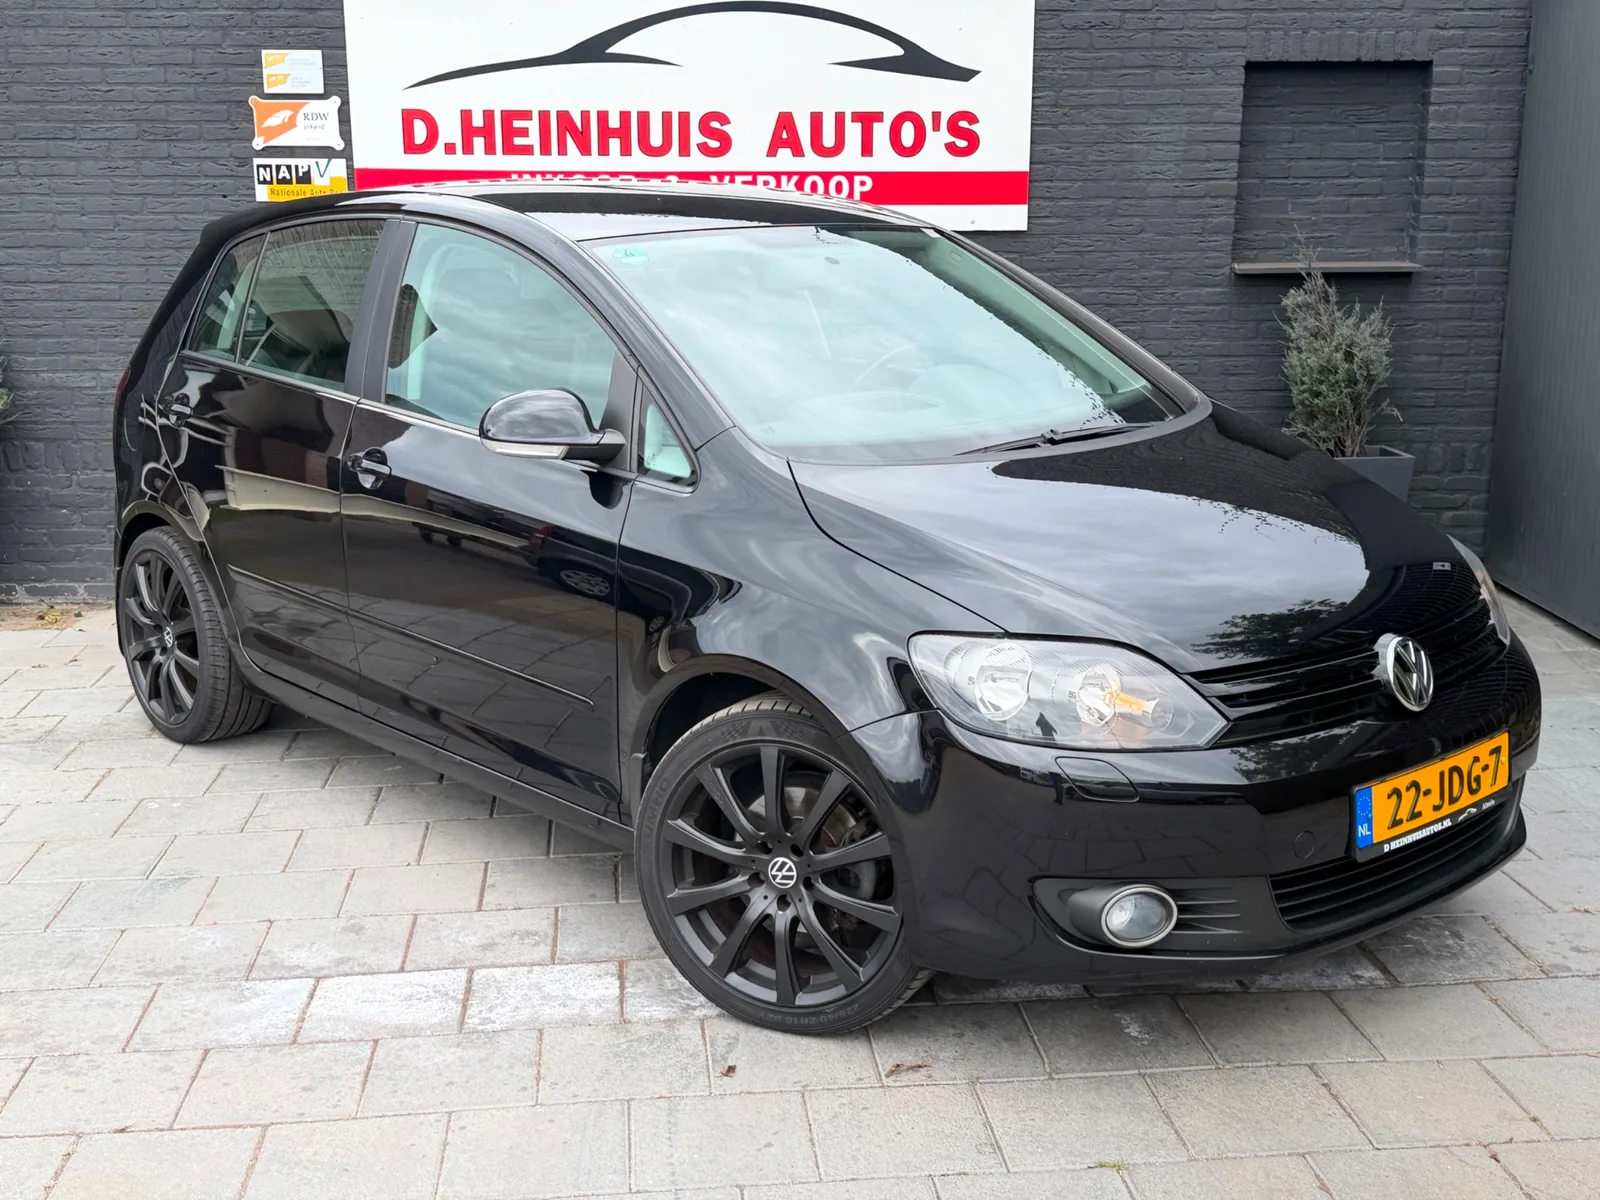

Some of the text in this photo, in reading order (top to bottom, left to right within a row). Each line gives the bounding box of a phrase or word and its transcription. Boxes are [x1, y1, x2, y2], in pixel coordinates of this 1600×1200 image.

[303, 112, 329, 121] RDW
[401, 109, 980, 158] D.HEINHUIS AUTO'S
[270, 188, 307, 197] Nationale
[1387, 745, 1502, 830] 22-JDG-7
[1358, 823, 1371, 837] NL
